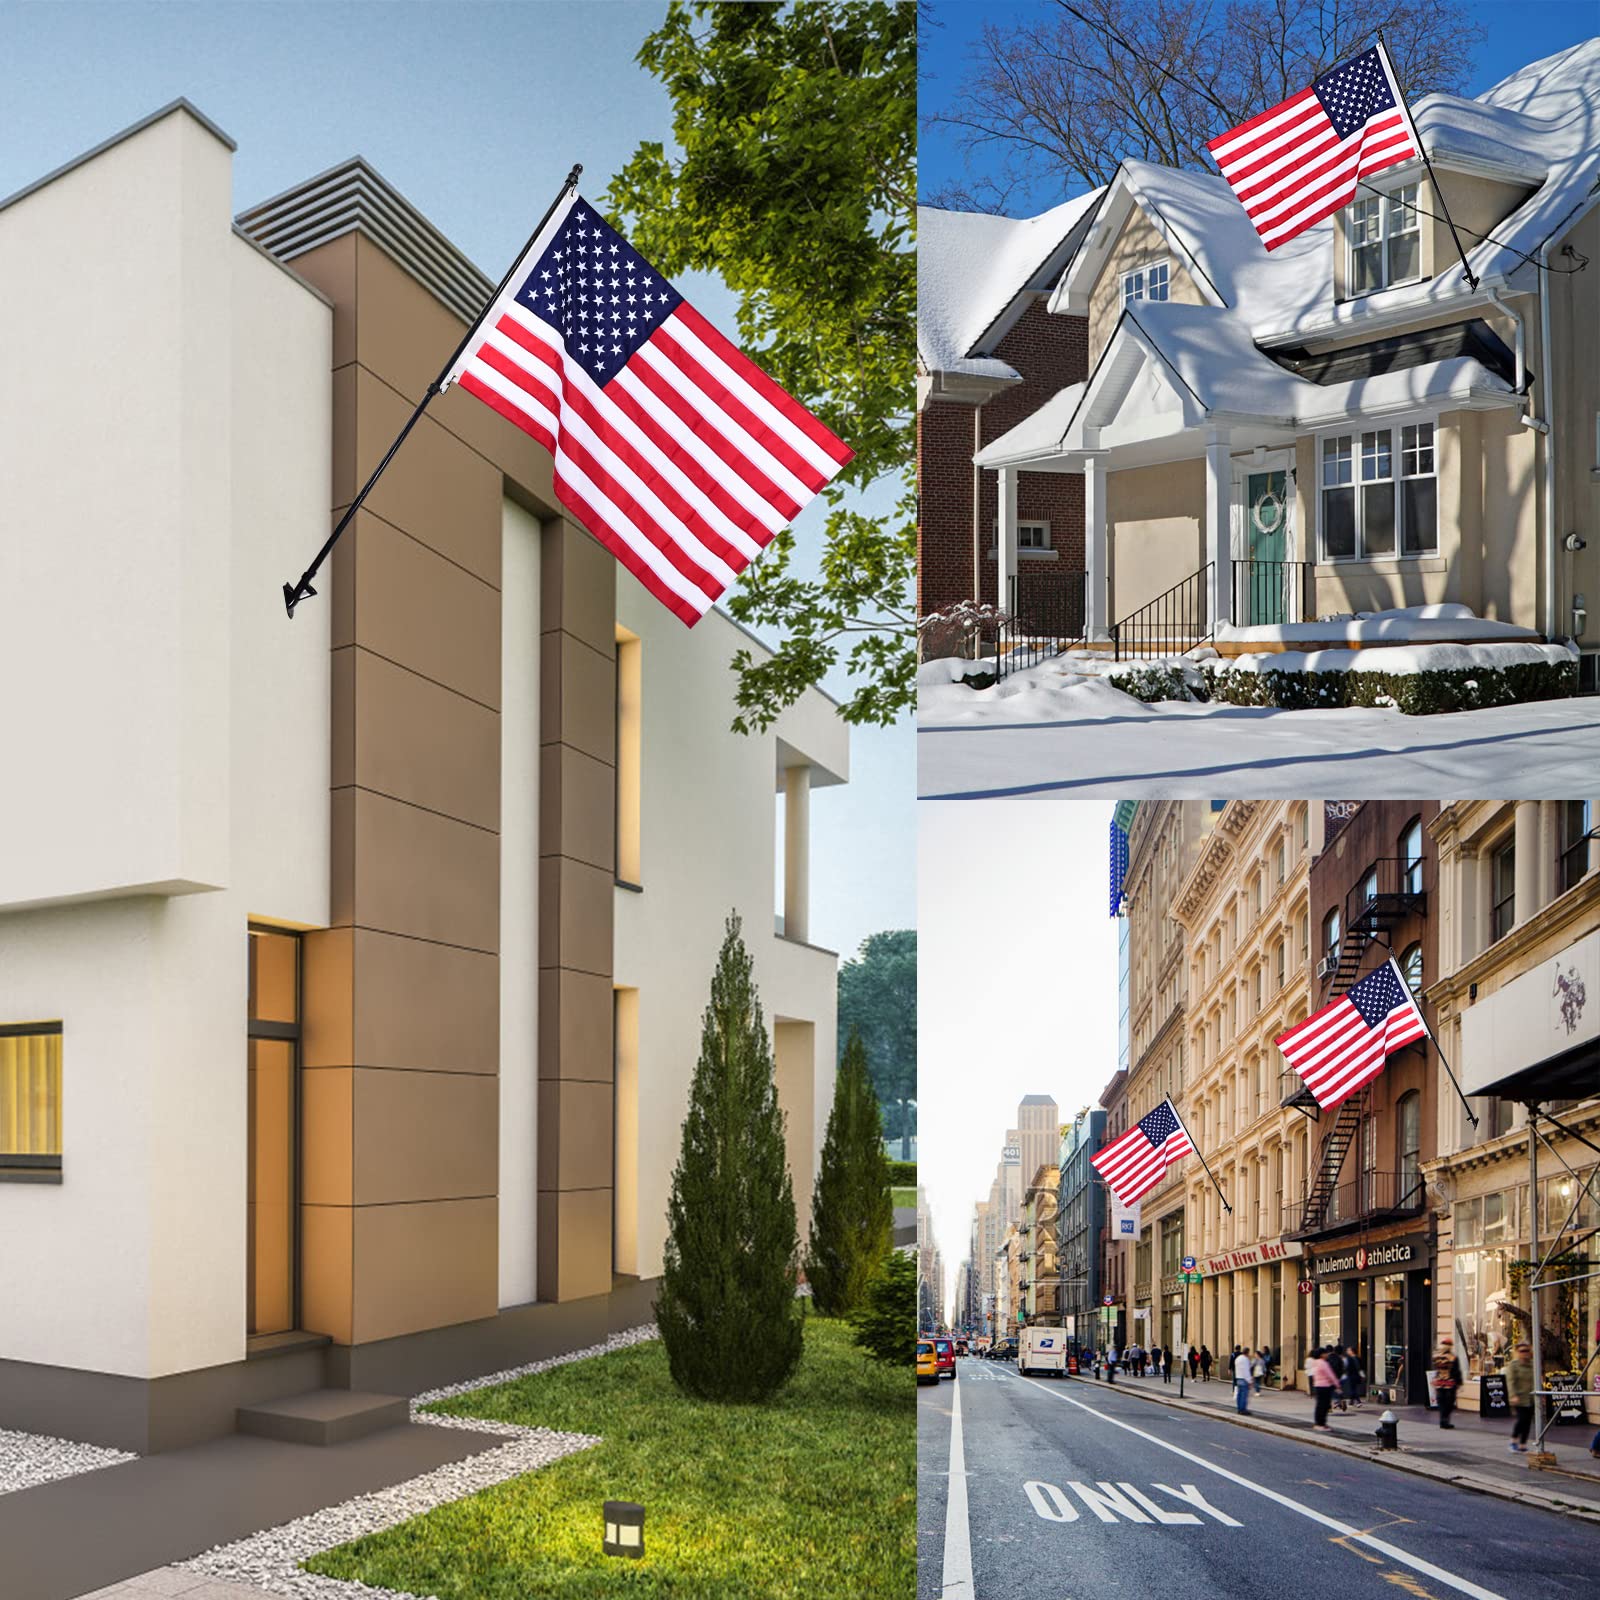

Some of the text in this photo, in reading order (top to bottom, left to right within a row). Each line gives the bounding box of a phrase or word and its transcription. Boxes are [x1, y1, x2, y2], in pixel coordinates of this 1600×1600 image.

[1208, 1255, 1231, 1273] Pearl
[1231, 1251, 1258, 1266] River
[1316, 1244, 1411, 1274] lululemon athletica
[1023, 1481, 1245, 1527] ONLY
